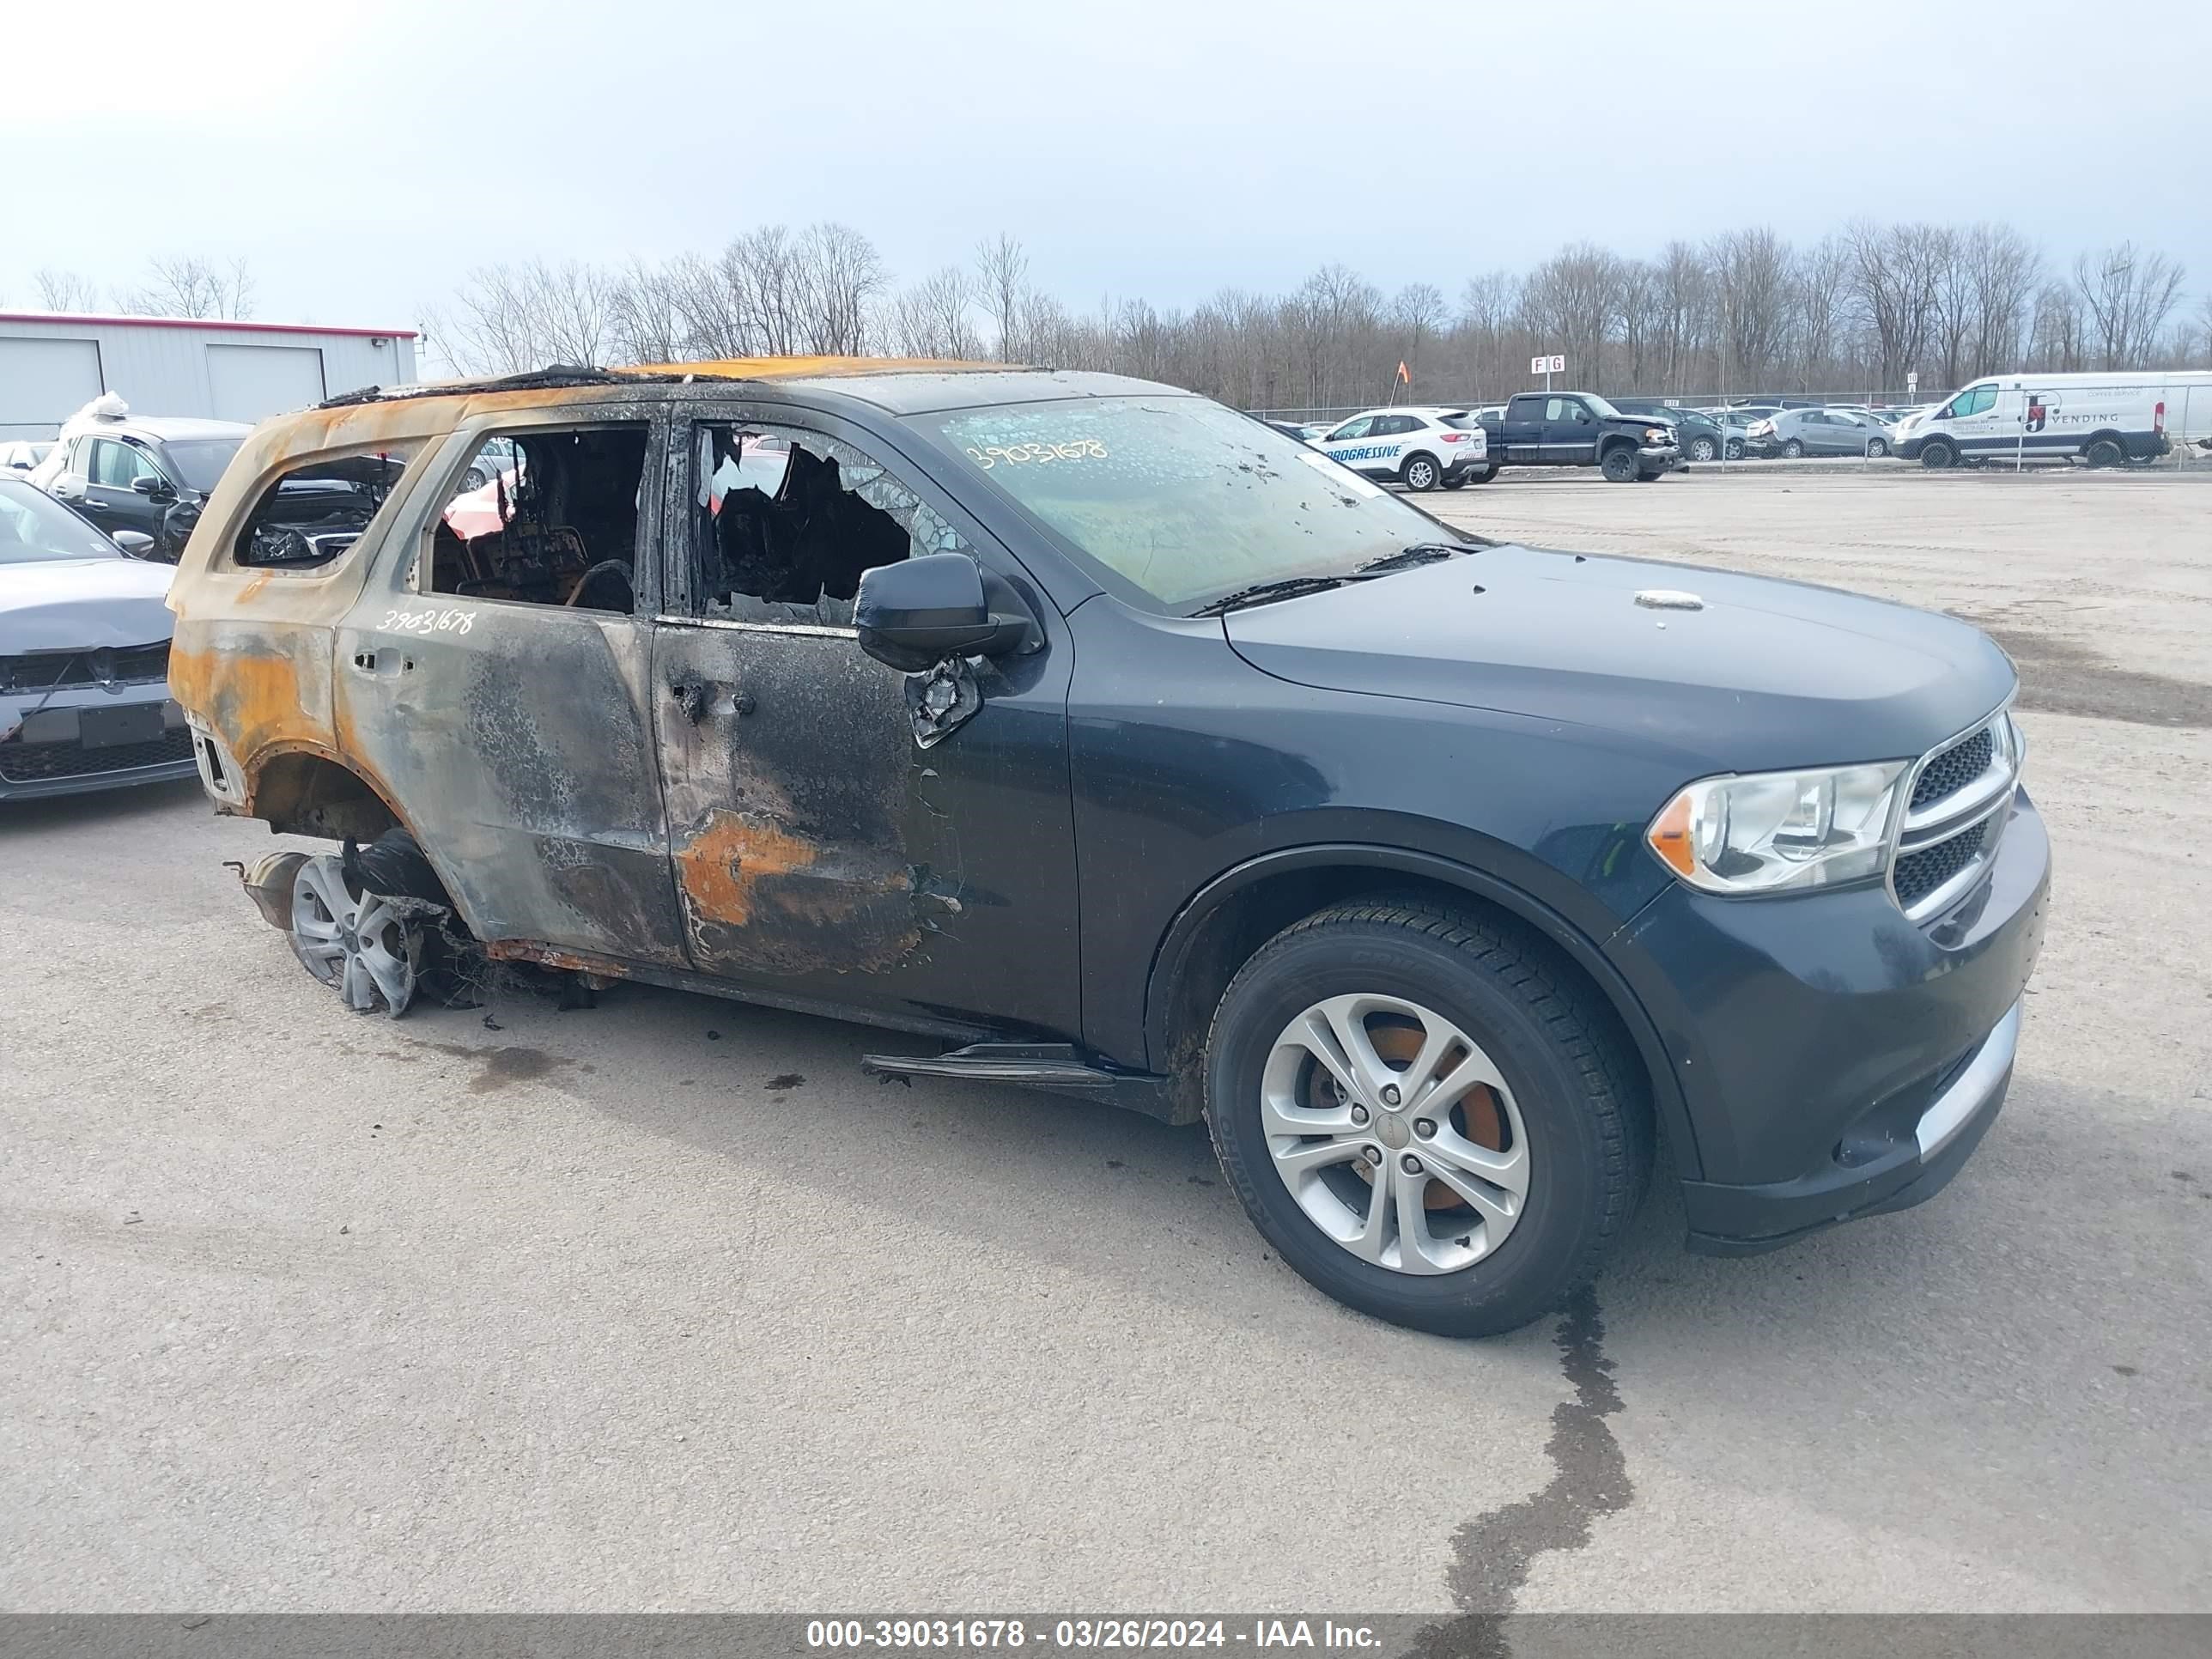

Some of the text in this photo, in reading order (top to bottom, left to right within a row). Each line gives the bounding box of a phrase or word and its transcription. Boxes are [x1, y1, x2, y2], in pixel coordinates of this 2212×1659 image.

[1535, 357, 1561, 372] F G
[2051, 413, 2119, 423] VENDING
[966, 439, 1108, 470] 39031678
[375, 608, 477, 635] 39031678
